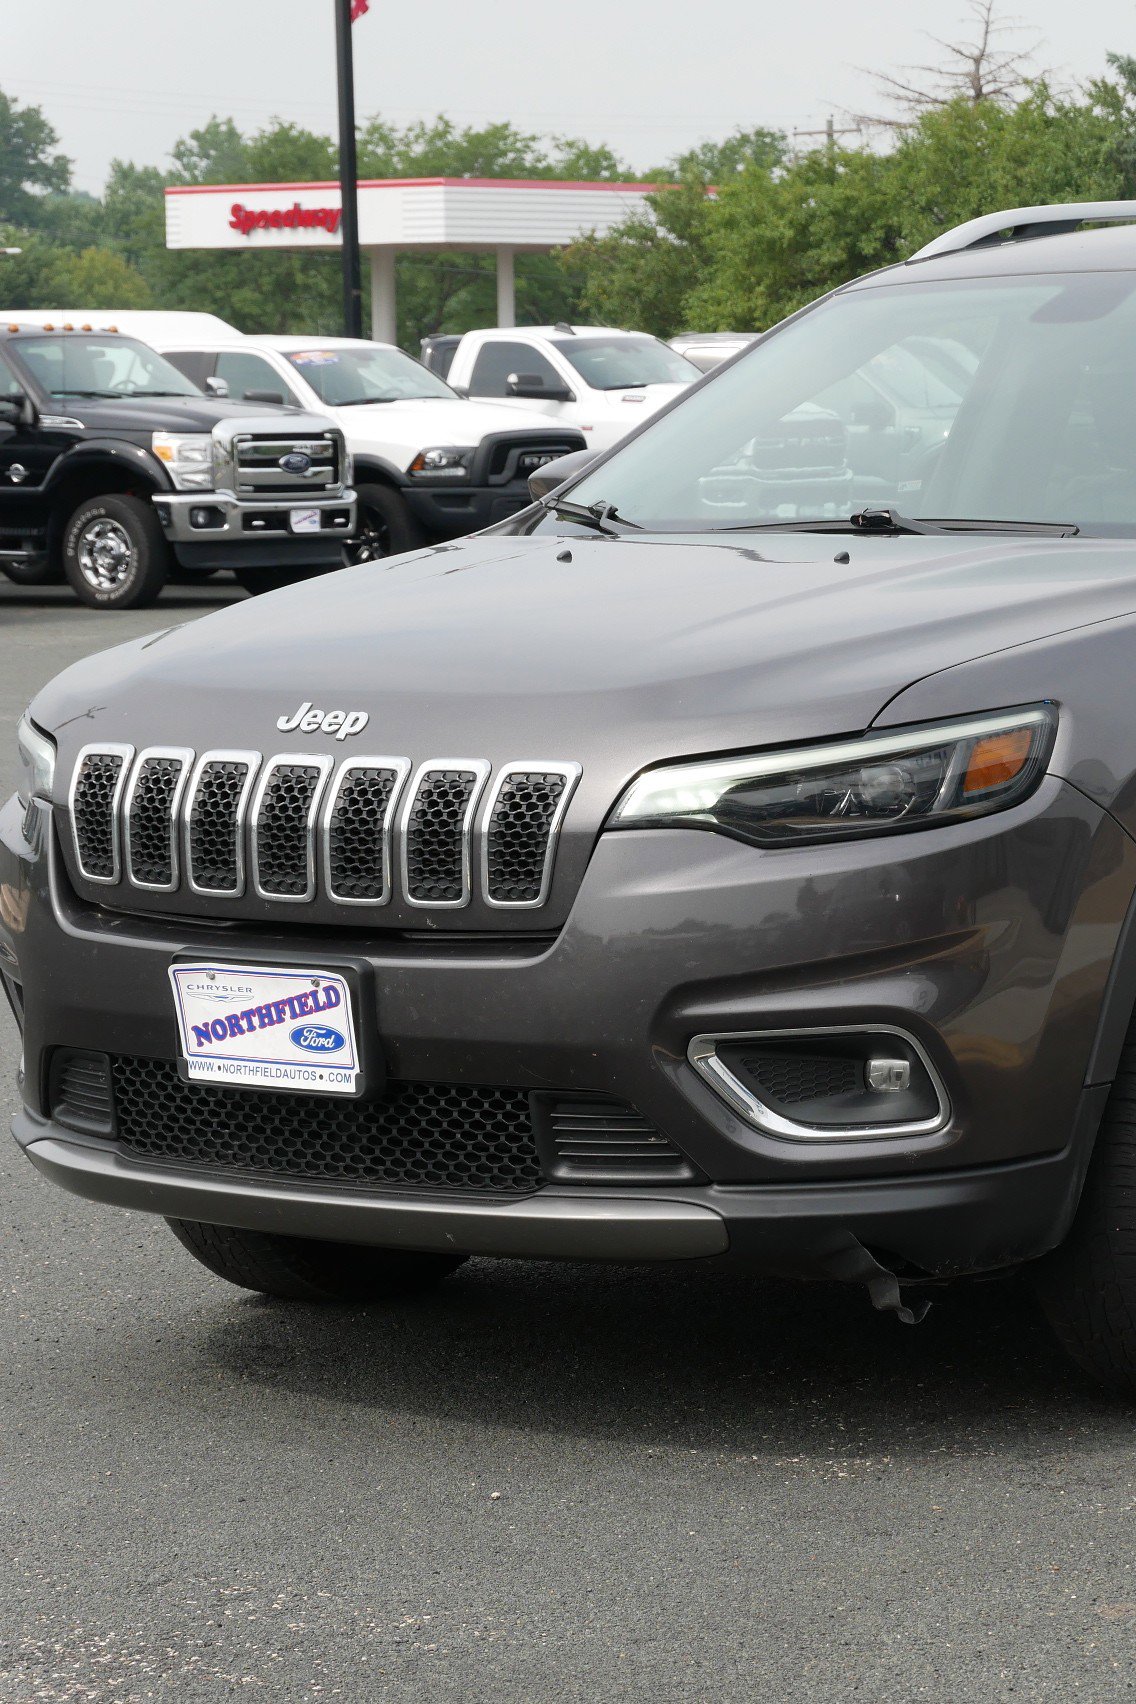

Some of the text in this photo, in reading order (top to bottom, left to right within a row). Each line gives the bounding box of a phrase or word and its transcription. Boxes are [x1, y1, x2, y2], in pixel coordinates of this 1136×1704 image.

[229, 202, 342, 234] Speedway
[277, 702, 369, 741] Jeep
[186, 983, 253, 993] CHRYSLER
[191, 985, 341, 1047] NORTHFIELD
[300, 1028, 335, 1048] Ford
